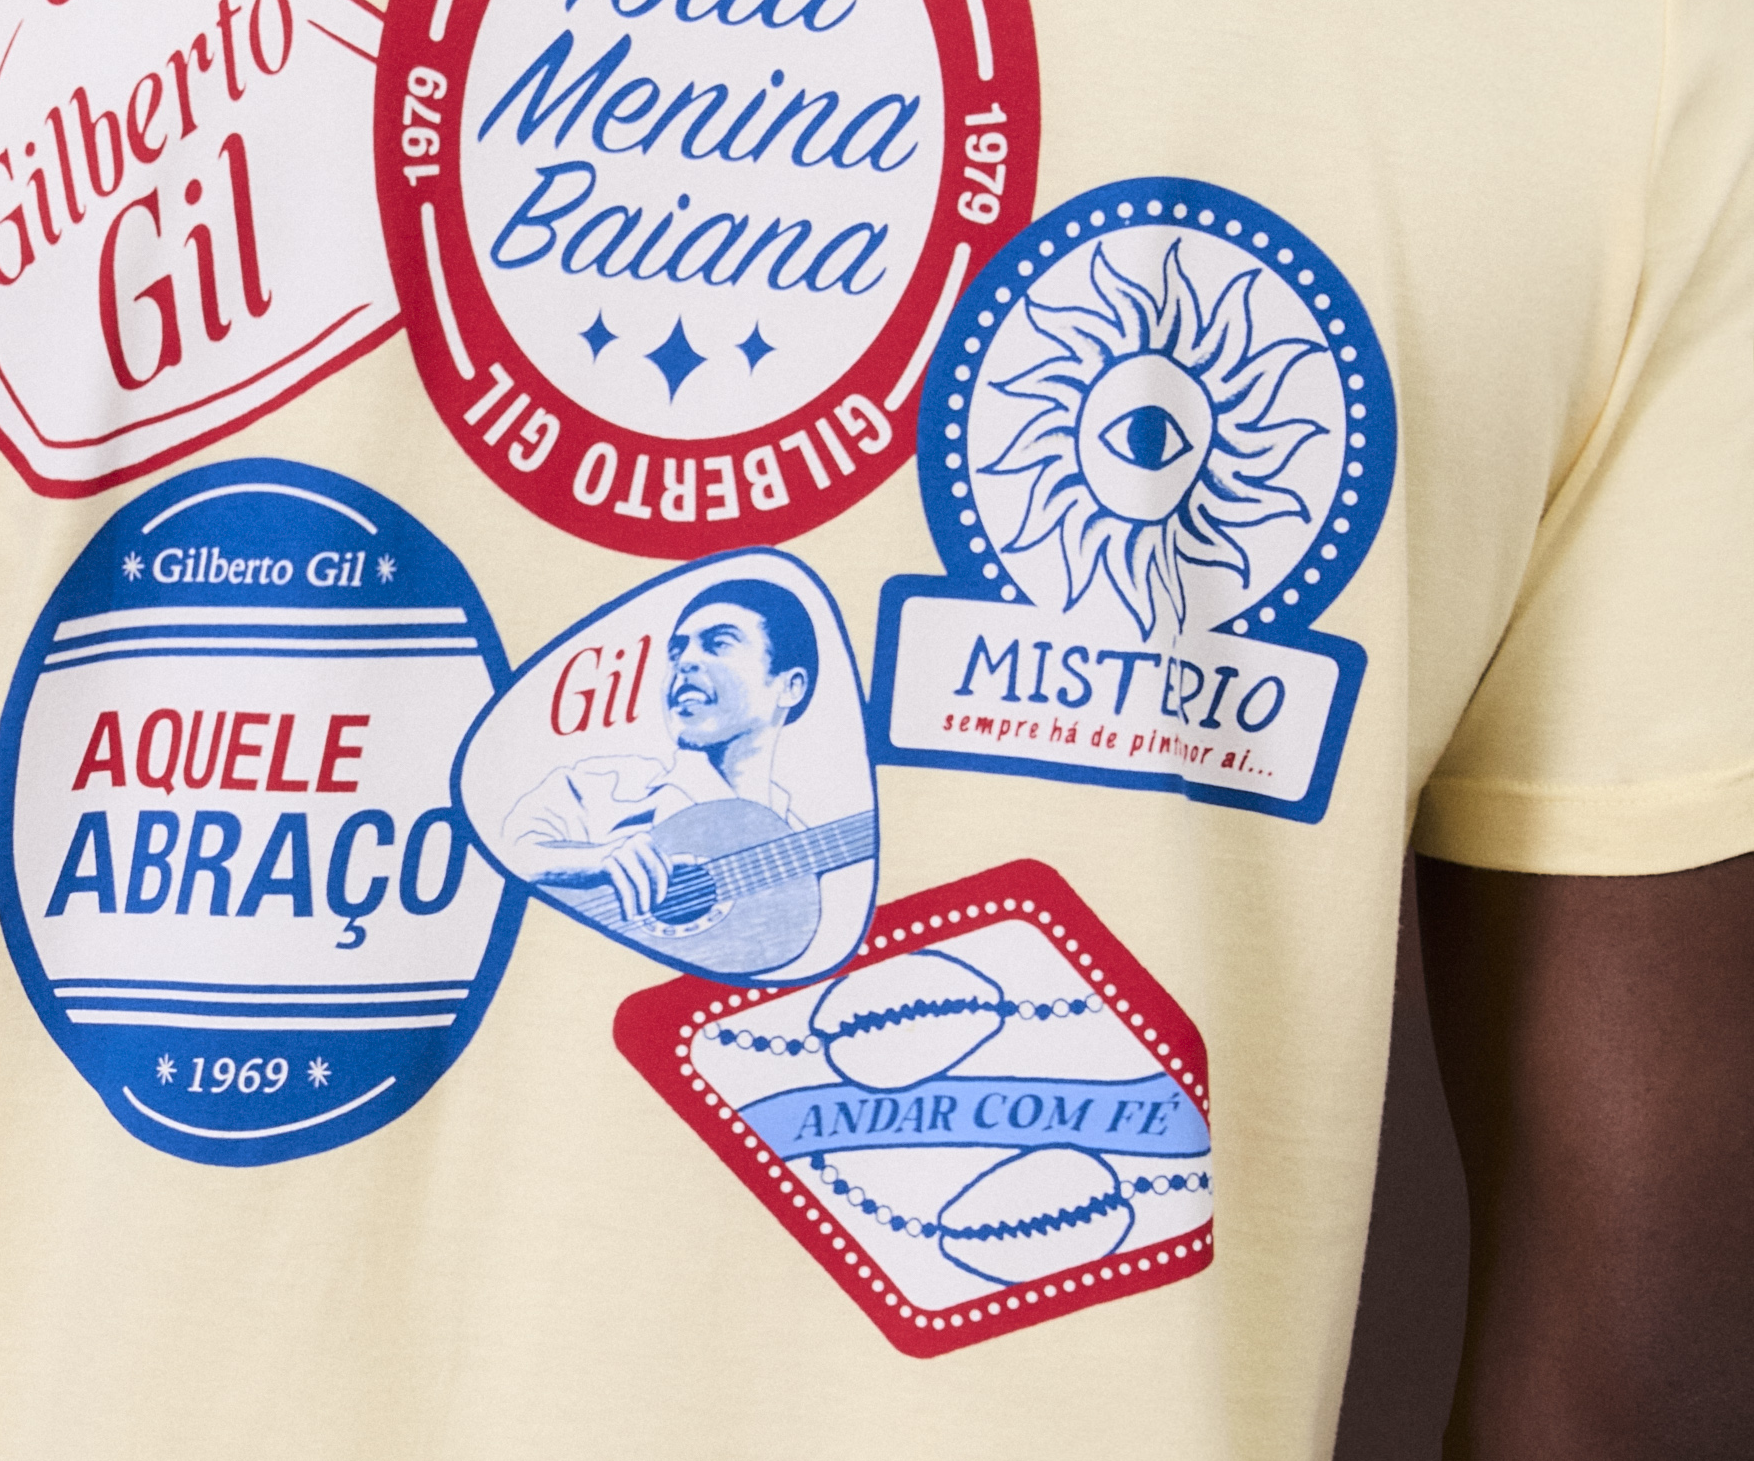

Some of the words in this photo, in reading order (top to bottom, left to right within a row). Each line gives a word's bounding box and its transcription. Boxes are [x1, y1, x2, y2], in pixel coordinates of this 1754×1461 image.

[400, 65, 449, 188] 1979
[476, 28, 922, 174] Menina
[956, 101, 1009, 226] 1979
[98, 132, 274, 393] Gil
[489, 158, 890, 297] Baiana
[462, 362, 561, 473] GIL
[572, 392, 894, 523] GILBERTO
[151, 546, 295, 586] Gilberto
[305, 550, 366, 589] Gil
[549, 634, 653, 738] Gil
[942, 712, 1040, 743] sempre
[1050, 719, 1078, 745] há
[1091, 725, 1119, 750] de
[71, 706, 372, 797] AQUELE
[45, 808, 468, 951] ABRAÇO
[187, 1056, 290, 1094] 1969
[794, 1095, 958, 1141] ANDAR
[972, 1092, 1094, 1133] COM
[1104, 1090, 1183, 1136] FÉ
